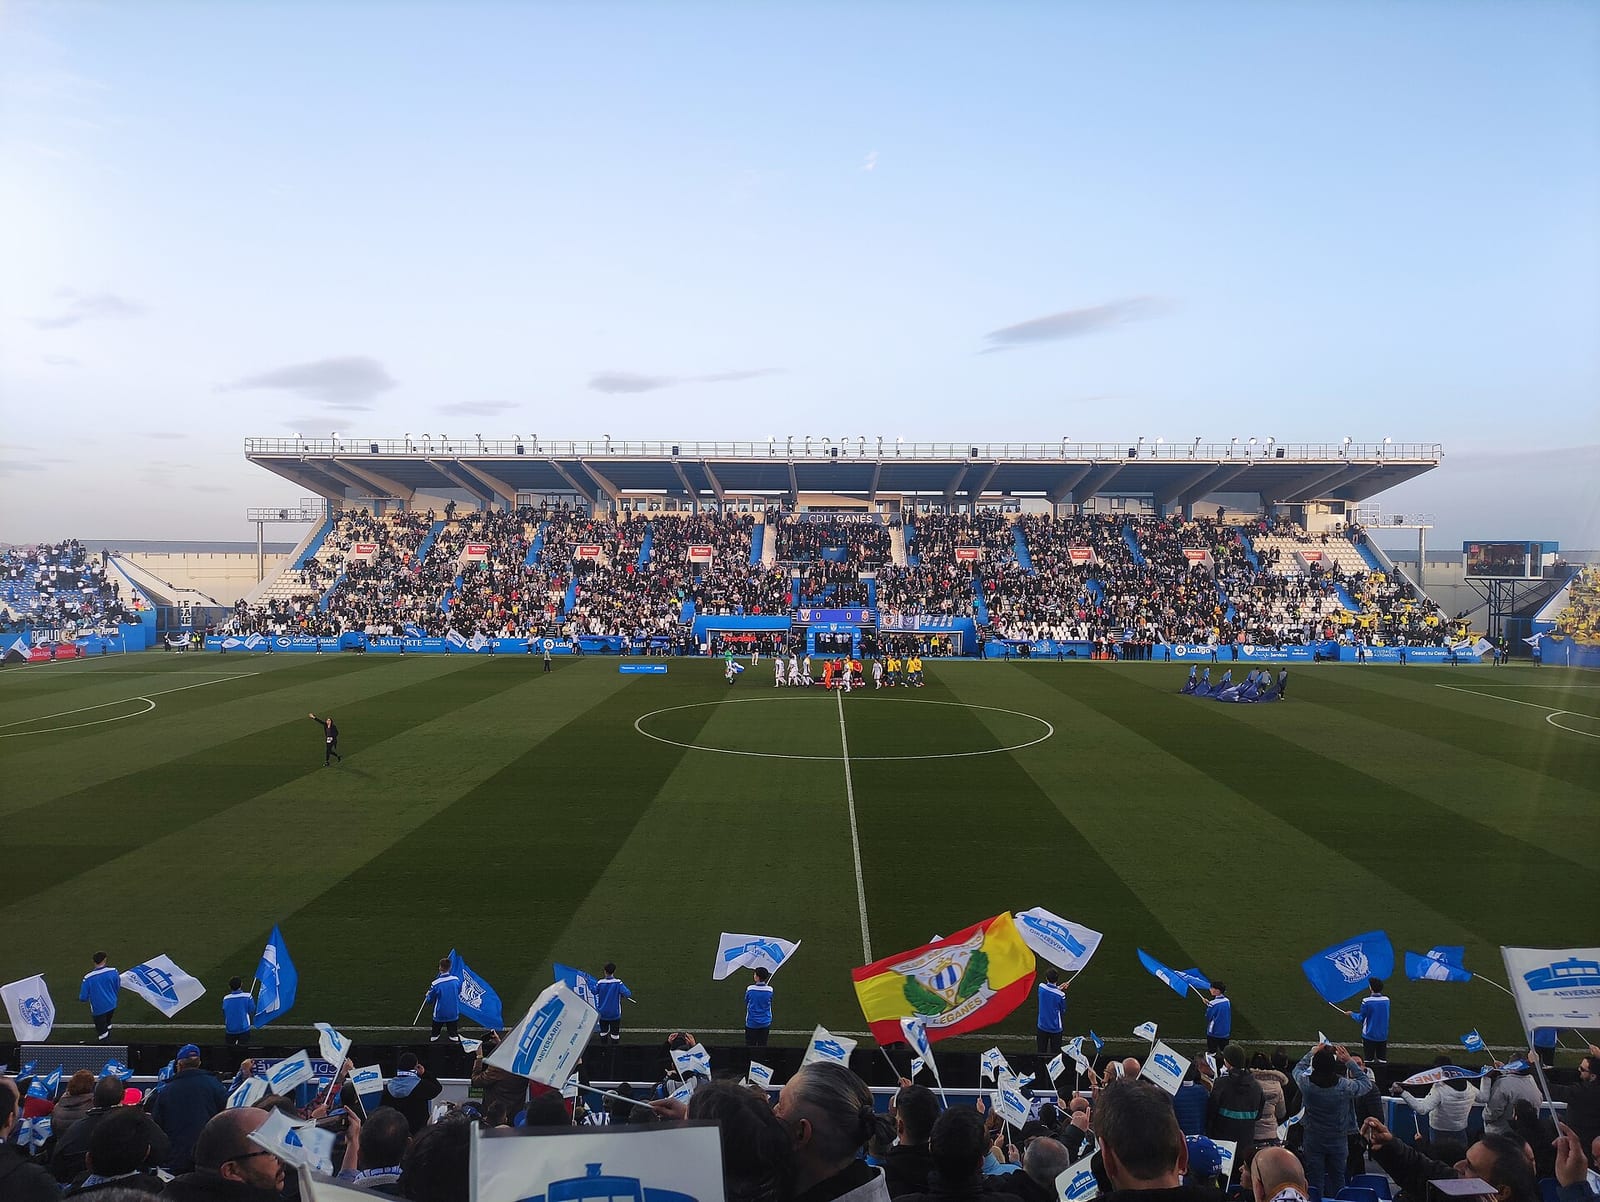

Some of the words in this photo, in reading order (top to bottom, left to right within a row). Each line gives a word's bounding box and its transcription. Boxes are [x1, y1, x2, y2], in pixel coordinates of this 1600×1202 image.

[815, 612, 821, 620] 0
[846, 612, 851, 620] 0
[537, 1020, 562, 1063] ANIVERSARIO
